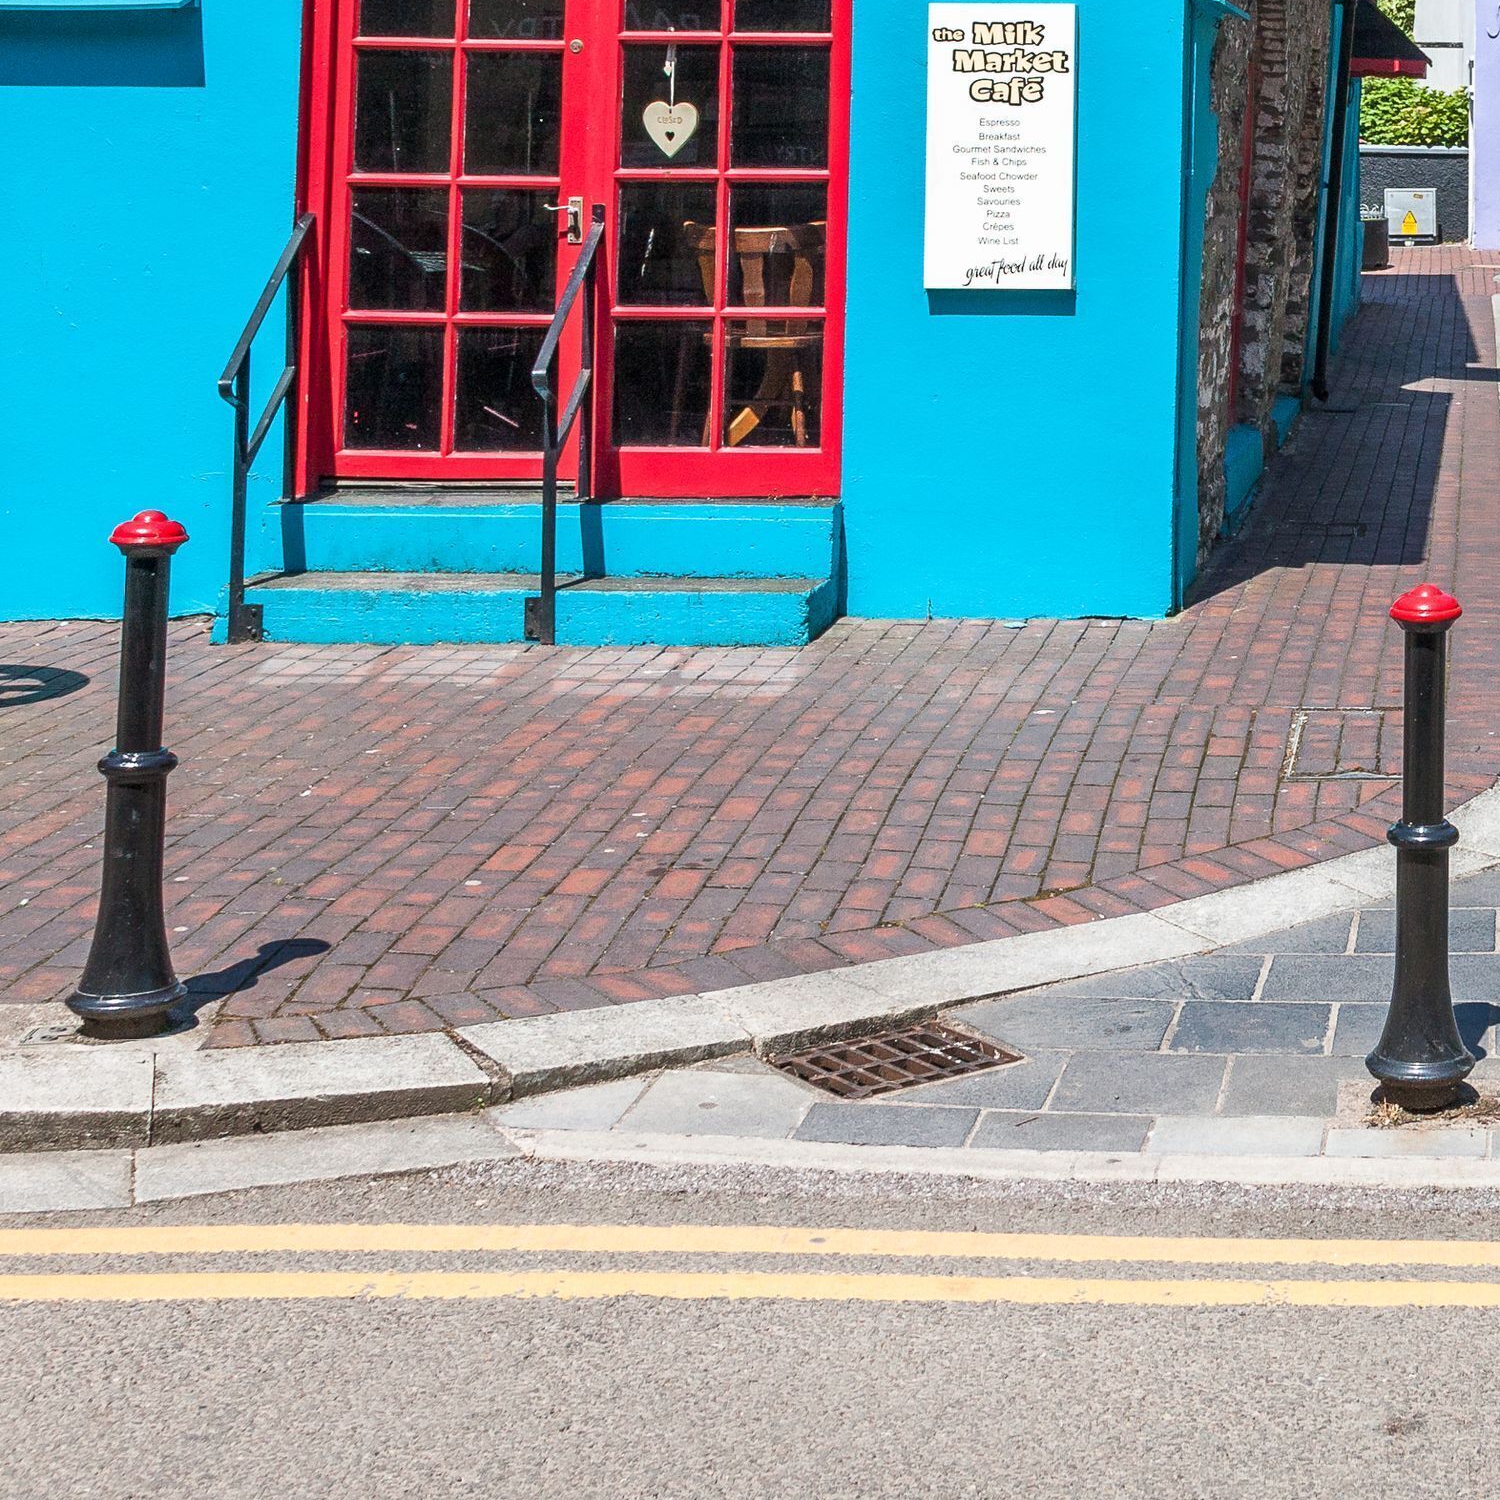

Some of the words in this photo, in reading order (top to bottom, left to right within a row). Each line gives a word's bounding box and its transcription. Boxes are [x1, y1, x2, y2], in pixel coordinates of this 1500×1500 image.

[932, 27, 965, 42] the
[972, 21, 1046, 46] Milk
[953, 48, 1070, 74] Market
[969, 76, 1045, 107] Café
[979, 118, 1021, 128] Espresso
[978, 132, 1020, 141] Breakfast
[952, 145, 991, 154] Gourmet
[993, 145, 1047, 154] Sandwiches
[971, 158, 990, 166] Fish
[992, 158, 999, 166] &
[1001, 158, 1027, 167] Chips
[960, 172, 996, 180] Seafood
[999, 172, 1038, 180] Chowder
[983, 185, 1015, 193] Sweets
[977, 197, 1021, 206] Savouries
[986, 210, 1011, 218] Pizza
[978, 237, 1000, 245] Wine
[1002, 237, 1019, 245] List
[962, 261, 998, 287] great
[995, 255, 1027, 284] food
[1028, 254, 1044, 271] all
[1047, 252, 1068, 277] day
